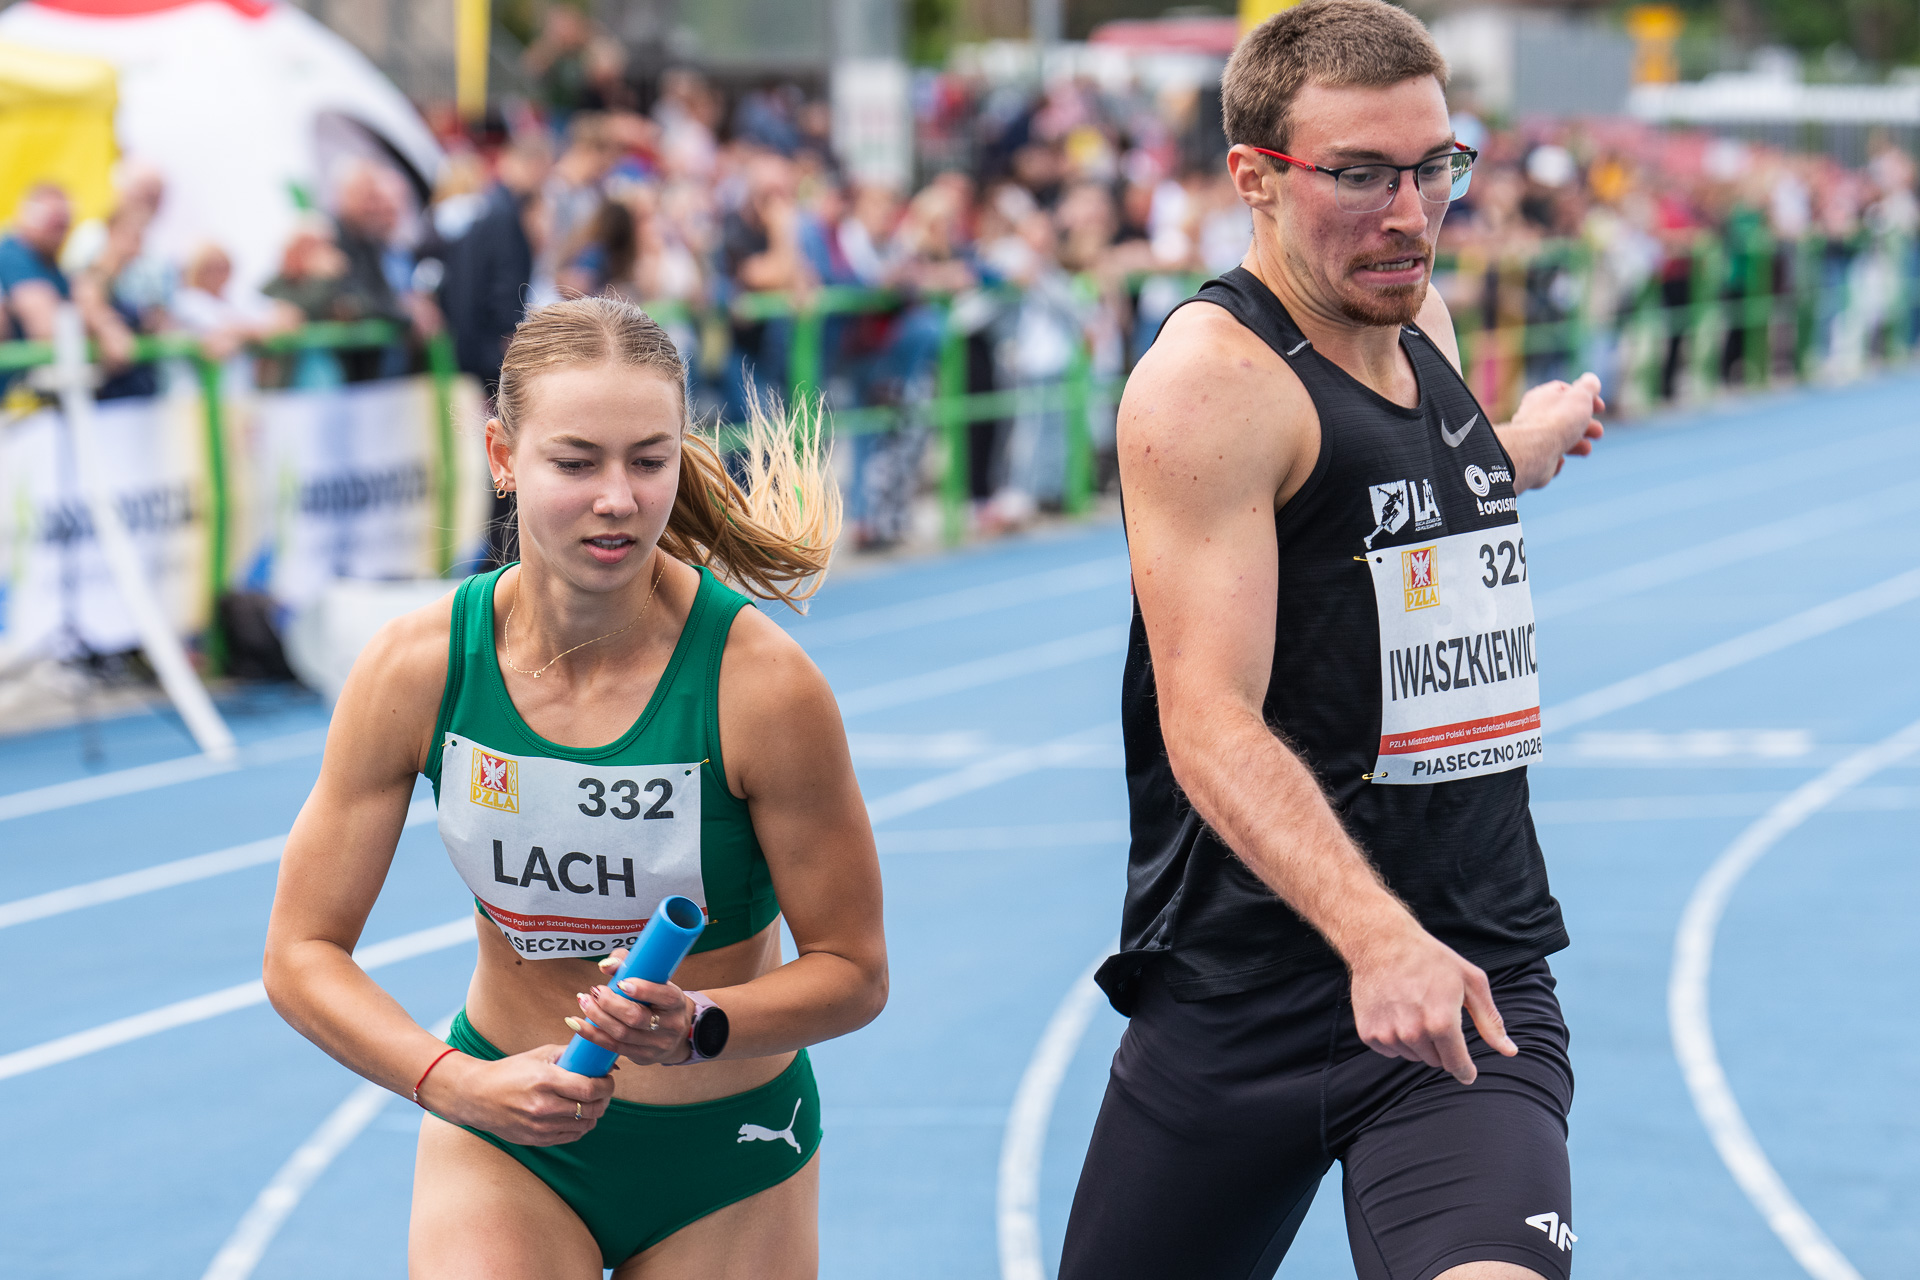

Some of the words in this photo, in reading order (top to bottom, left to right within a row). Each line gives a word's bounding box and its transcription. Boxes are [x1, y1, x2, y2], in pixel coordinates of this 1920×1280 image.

[1488, 470, 1512, 484] OPOLE
[1479, 537, 1527, 589] 329
[1406, 587, 1437, 609] PZLA
[1389, 621, 1539, 702] IWASZKIEWIC
[1389, 739, 1407, 749] PZLA
[1407, 732, 1446, 747] Mistrzostwa
[1445, 728, 1465, 740] Polski
[1465, 728, 1471, 736] w
[1472, 722, 1506, 735] Sztafetach
[1505, 716, 1529, 728] Mieszanych
[1411, 743, 1514, 777] PIASECZNO
[1516, 736, 1543, 759] 2026
[472, 786, 516, 812] PZLA
[577, 777, 675, 821] 332
[492, 839, 637, 899] LACH
[480, 901, 513, 923] strzostwa
[512, 917, 536, 927] Polski
[546, 919, 590, 929] Sztafetach
[591, 922, 642, 932] Mieszanych
[504, 930, 606, 953] ASECZNO
[611, 936, 639, 949] 20
